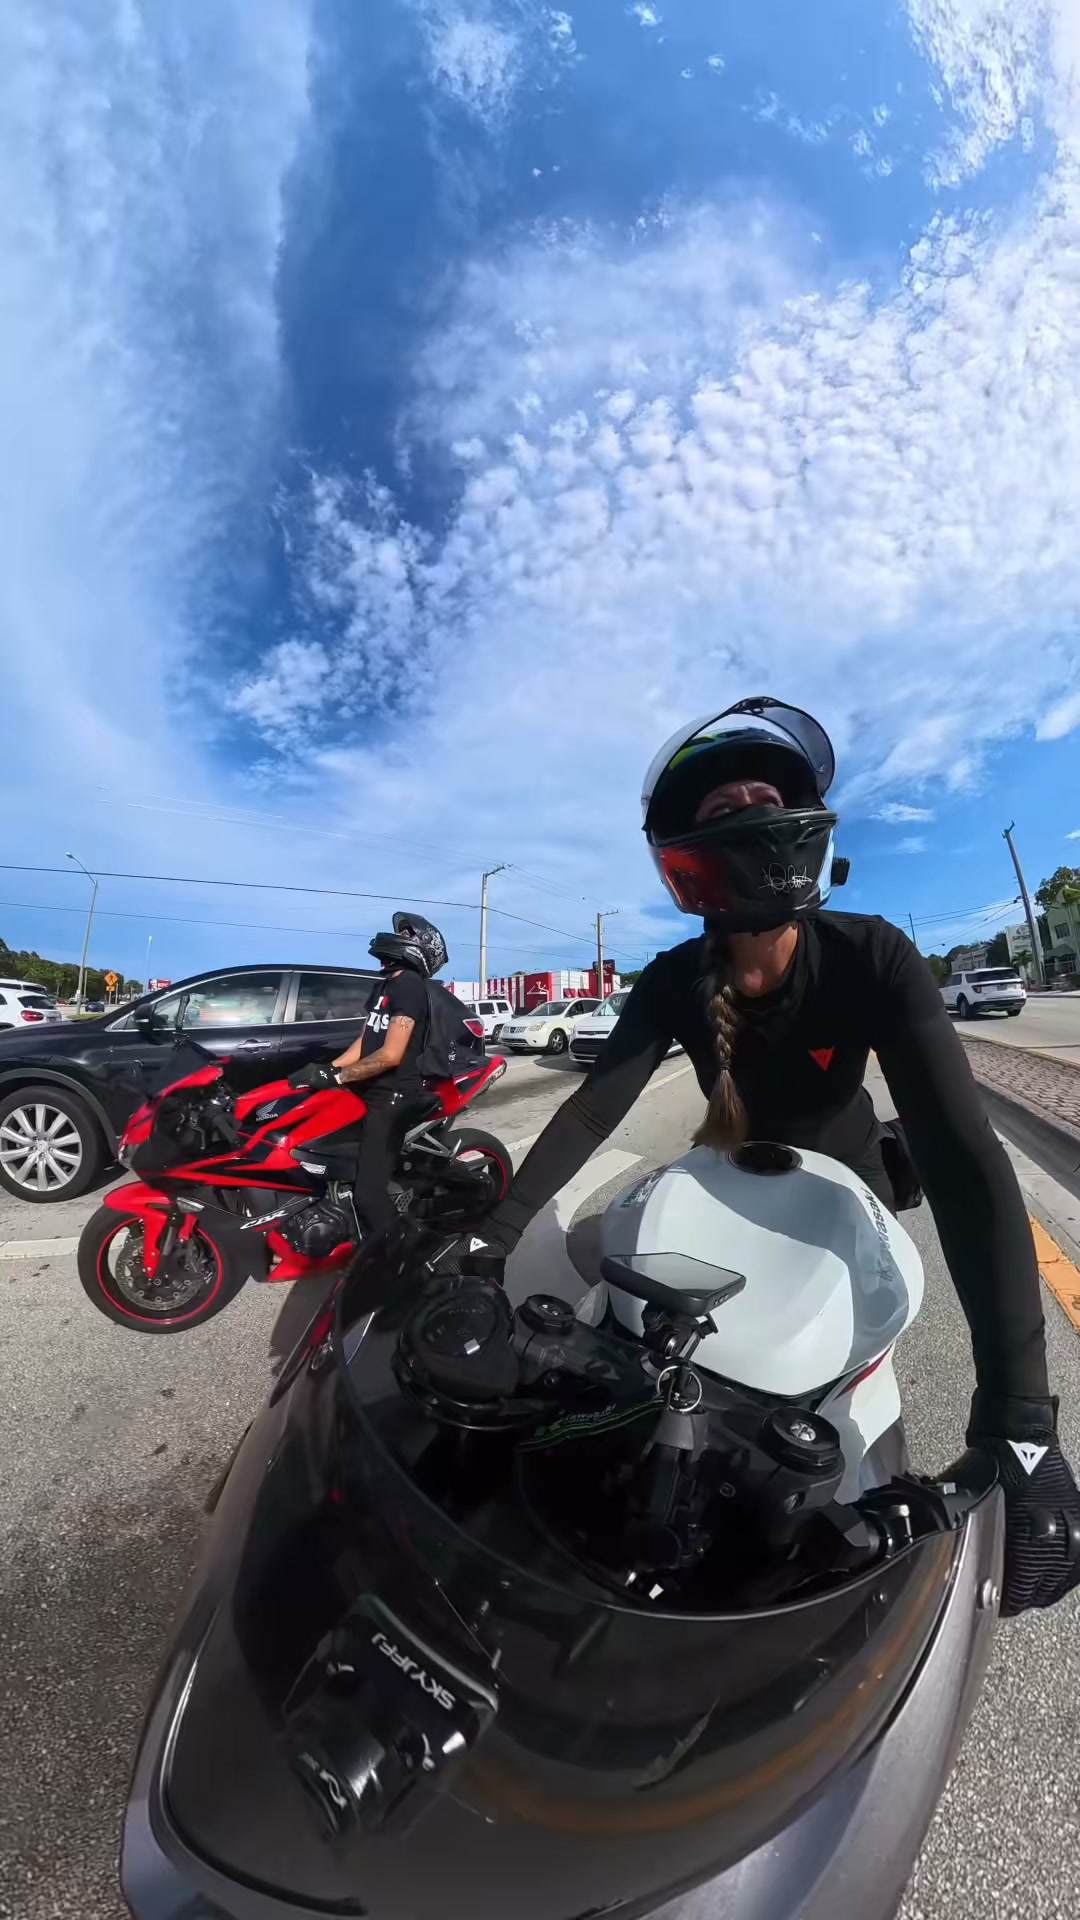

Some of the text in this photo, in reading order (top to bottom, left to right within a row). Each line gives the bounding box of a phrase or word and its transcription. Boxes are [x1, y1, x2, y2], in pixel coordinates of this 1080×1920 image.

[255, 1112, 279, 1122] HONDA
[240, 1210, 289, 1230] CBR
[371, 1632, 456, 1711] SKYJFFJ
